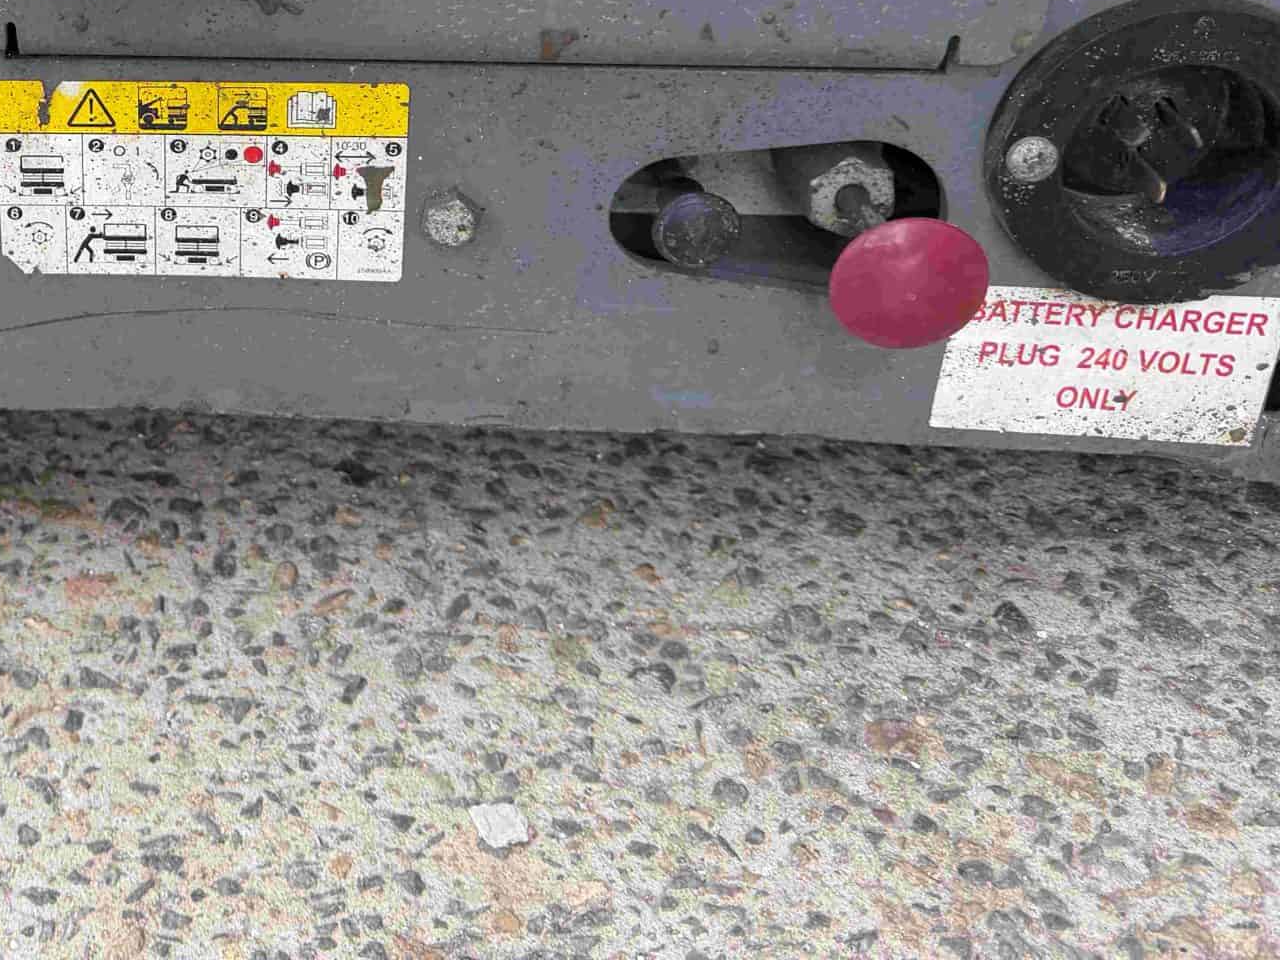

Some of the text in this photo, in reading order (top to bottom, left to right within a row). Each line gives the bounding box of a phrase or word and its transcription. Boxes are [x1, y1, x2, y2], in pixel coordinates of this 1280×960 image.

[1114, 305, 1269, 336] CHARGER
[978, 342, 1236, 377] PLUG 240 VOLTS
[1056, 386, 1138, 412] ONLY
